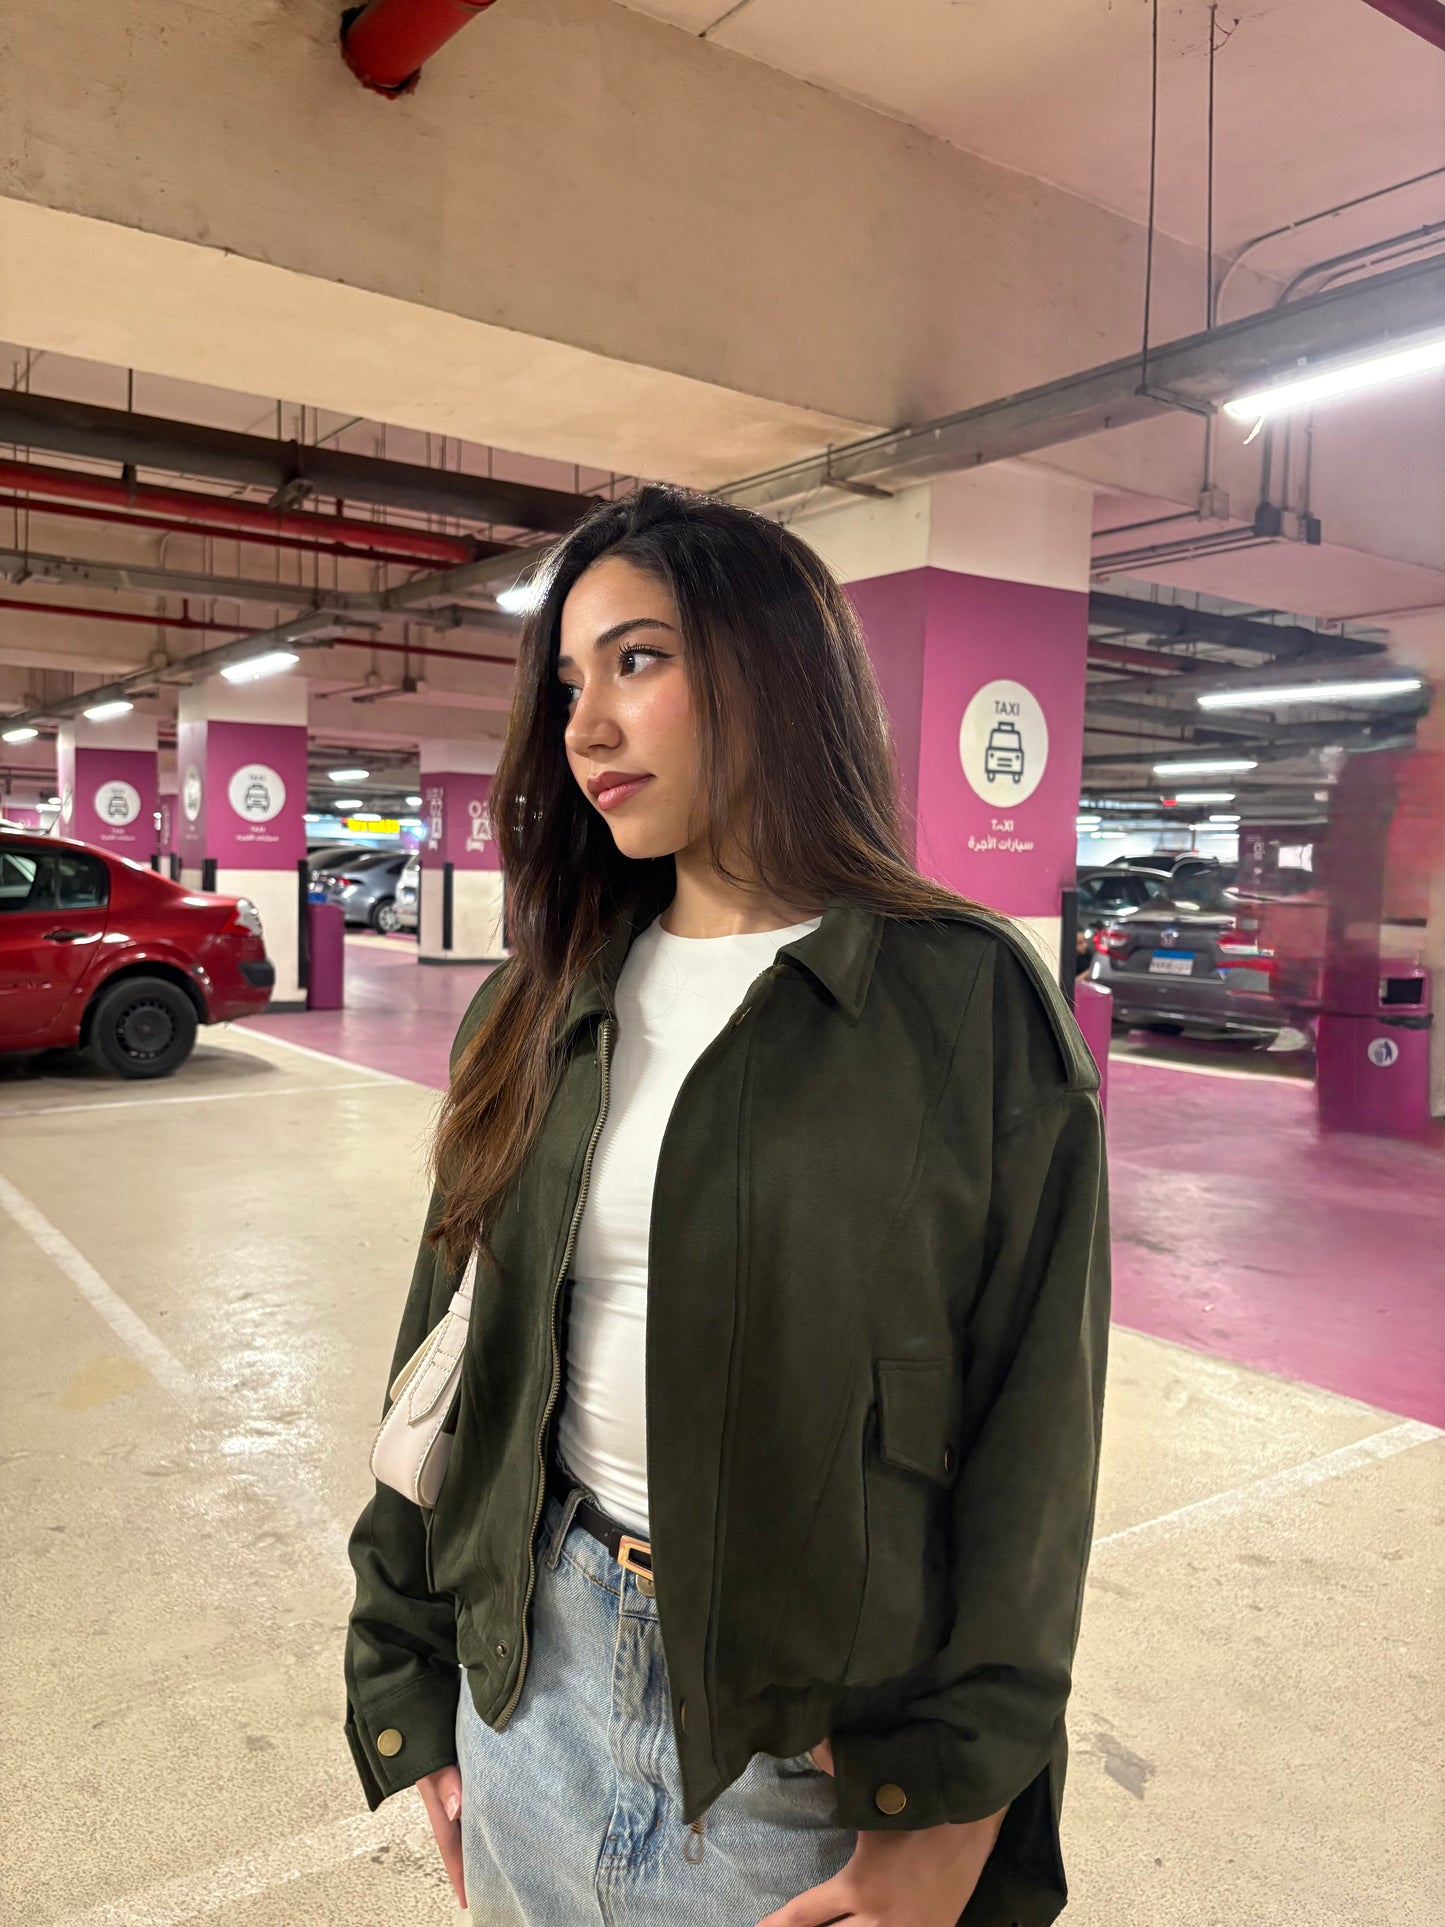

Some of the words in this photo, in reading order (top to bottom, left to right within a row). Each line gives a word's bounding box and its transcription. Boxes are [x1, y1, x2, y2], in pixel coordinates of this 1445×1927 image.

[994, 700, 1020, 716] TAXI
[968, 834, 996, 852] الأجرة
[998, 837, 1034, 853] سيارات
